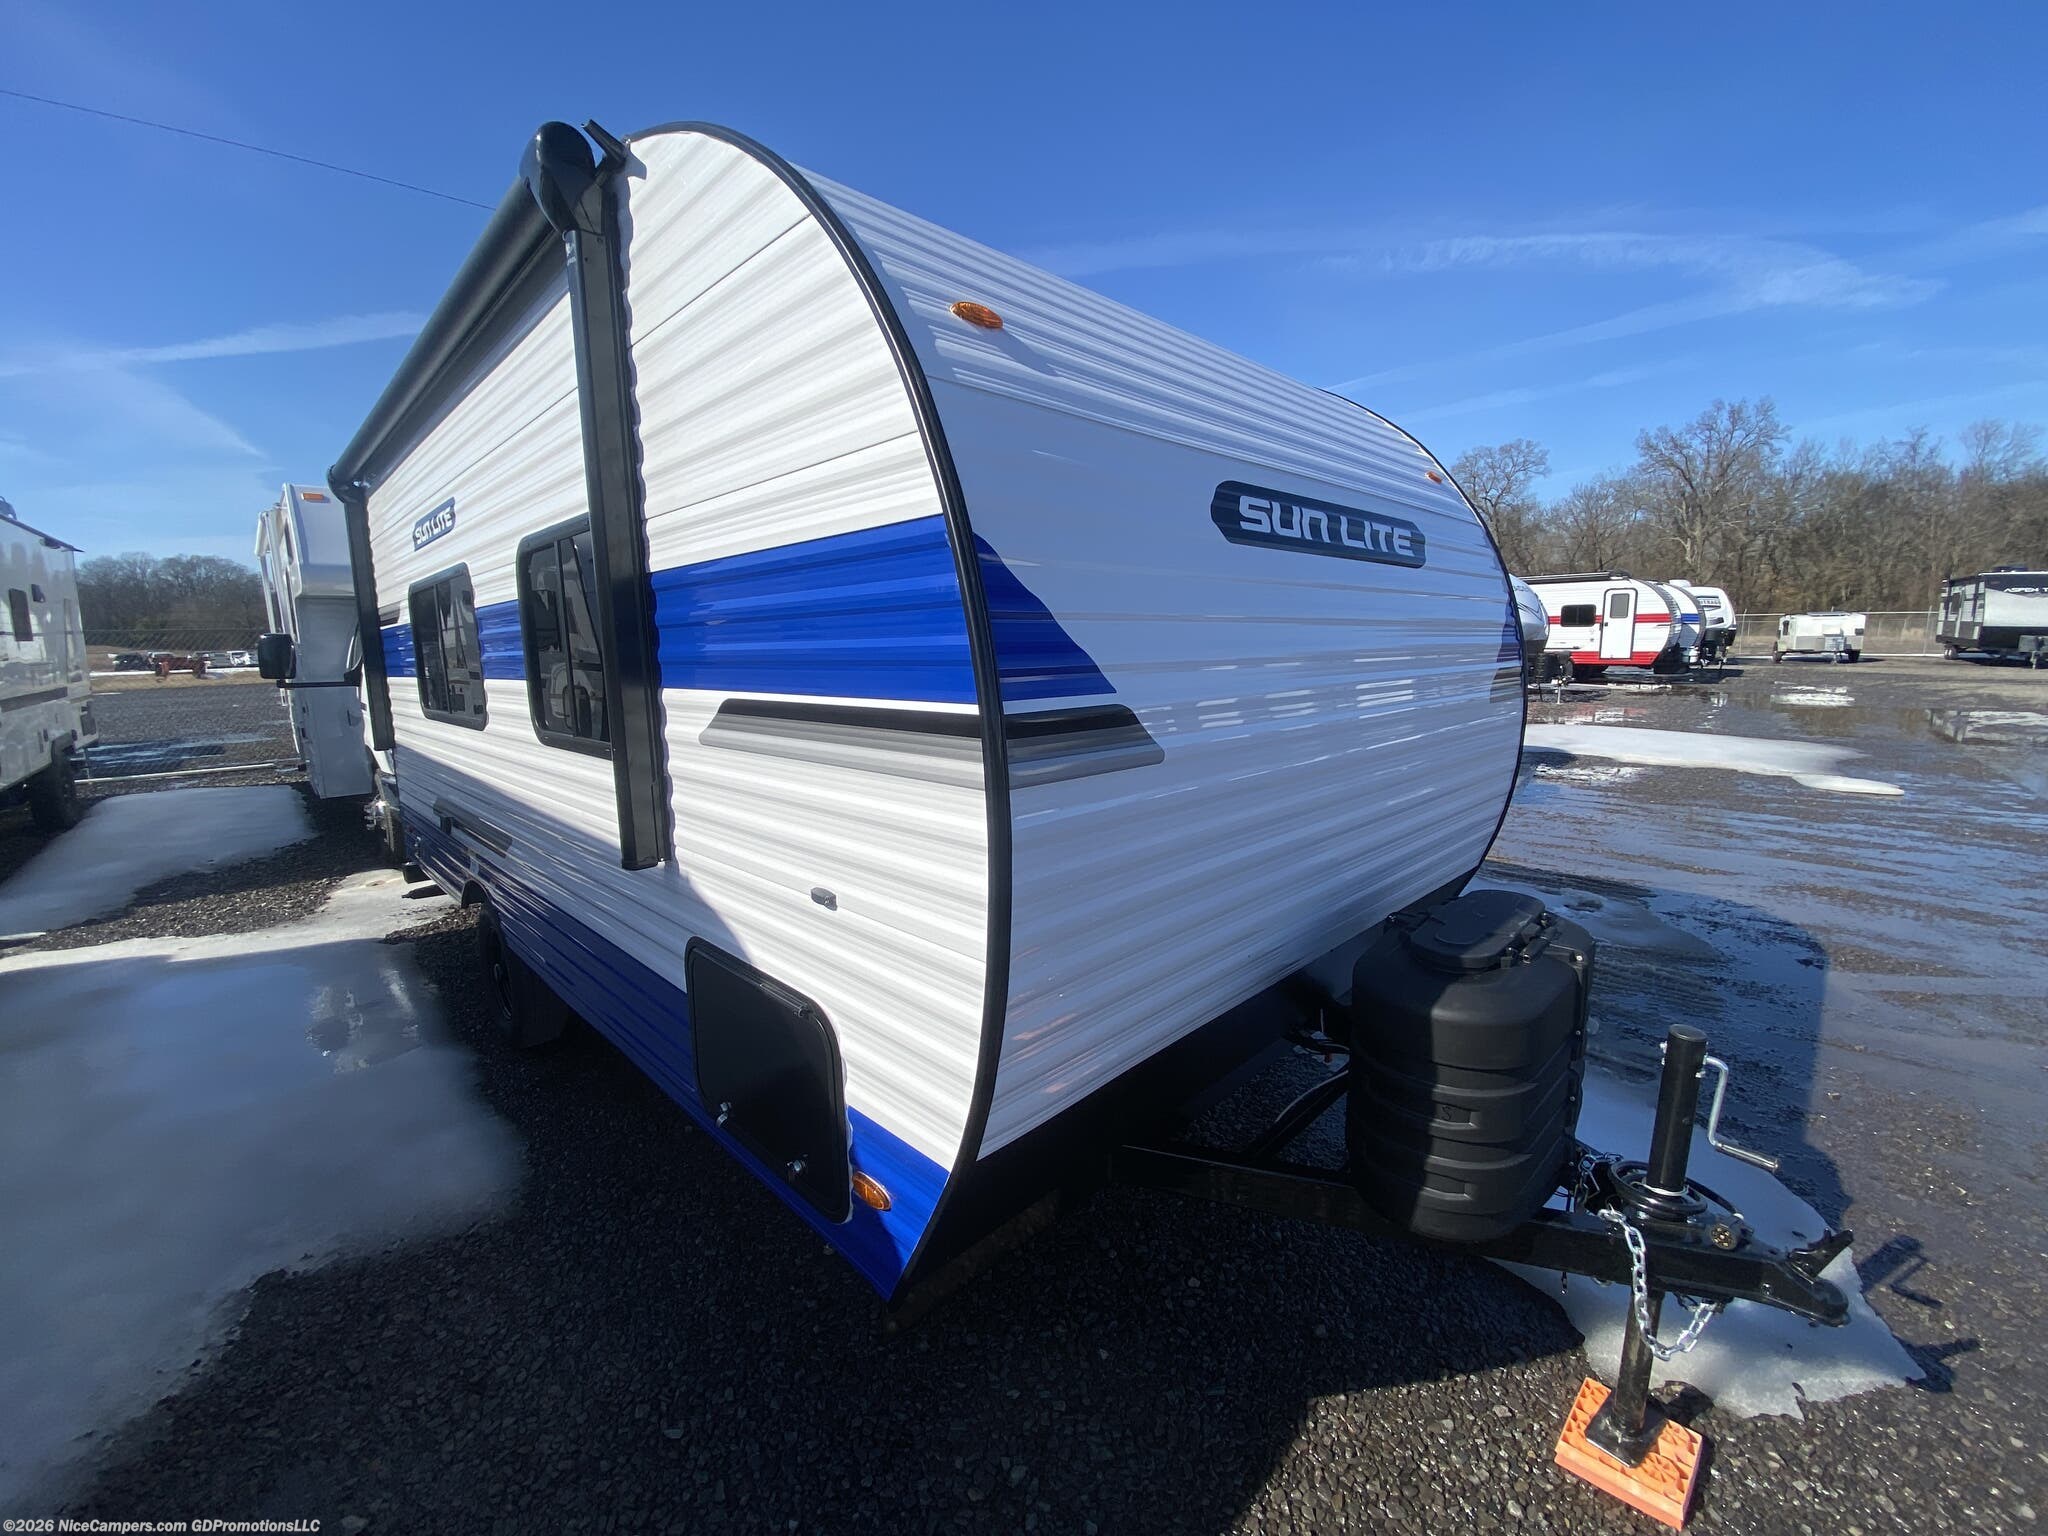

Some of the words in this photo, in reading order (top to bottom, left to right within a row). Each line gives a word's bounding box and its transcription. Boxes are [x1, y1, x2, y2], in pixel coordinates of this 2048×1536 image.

[415, 520, 431, 544] SUN
[432, 506, 452, 535] LITE
[1239, 495, 1331, 543] SUN
[1340, 515, 1415, 557] LITE
